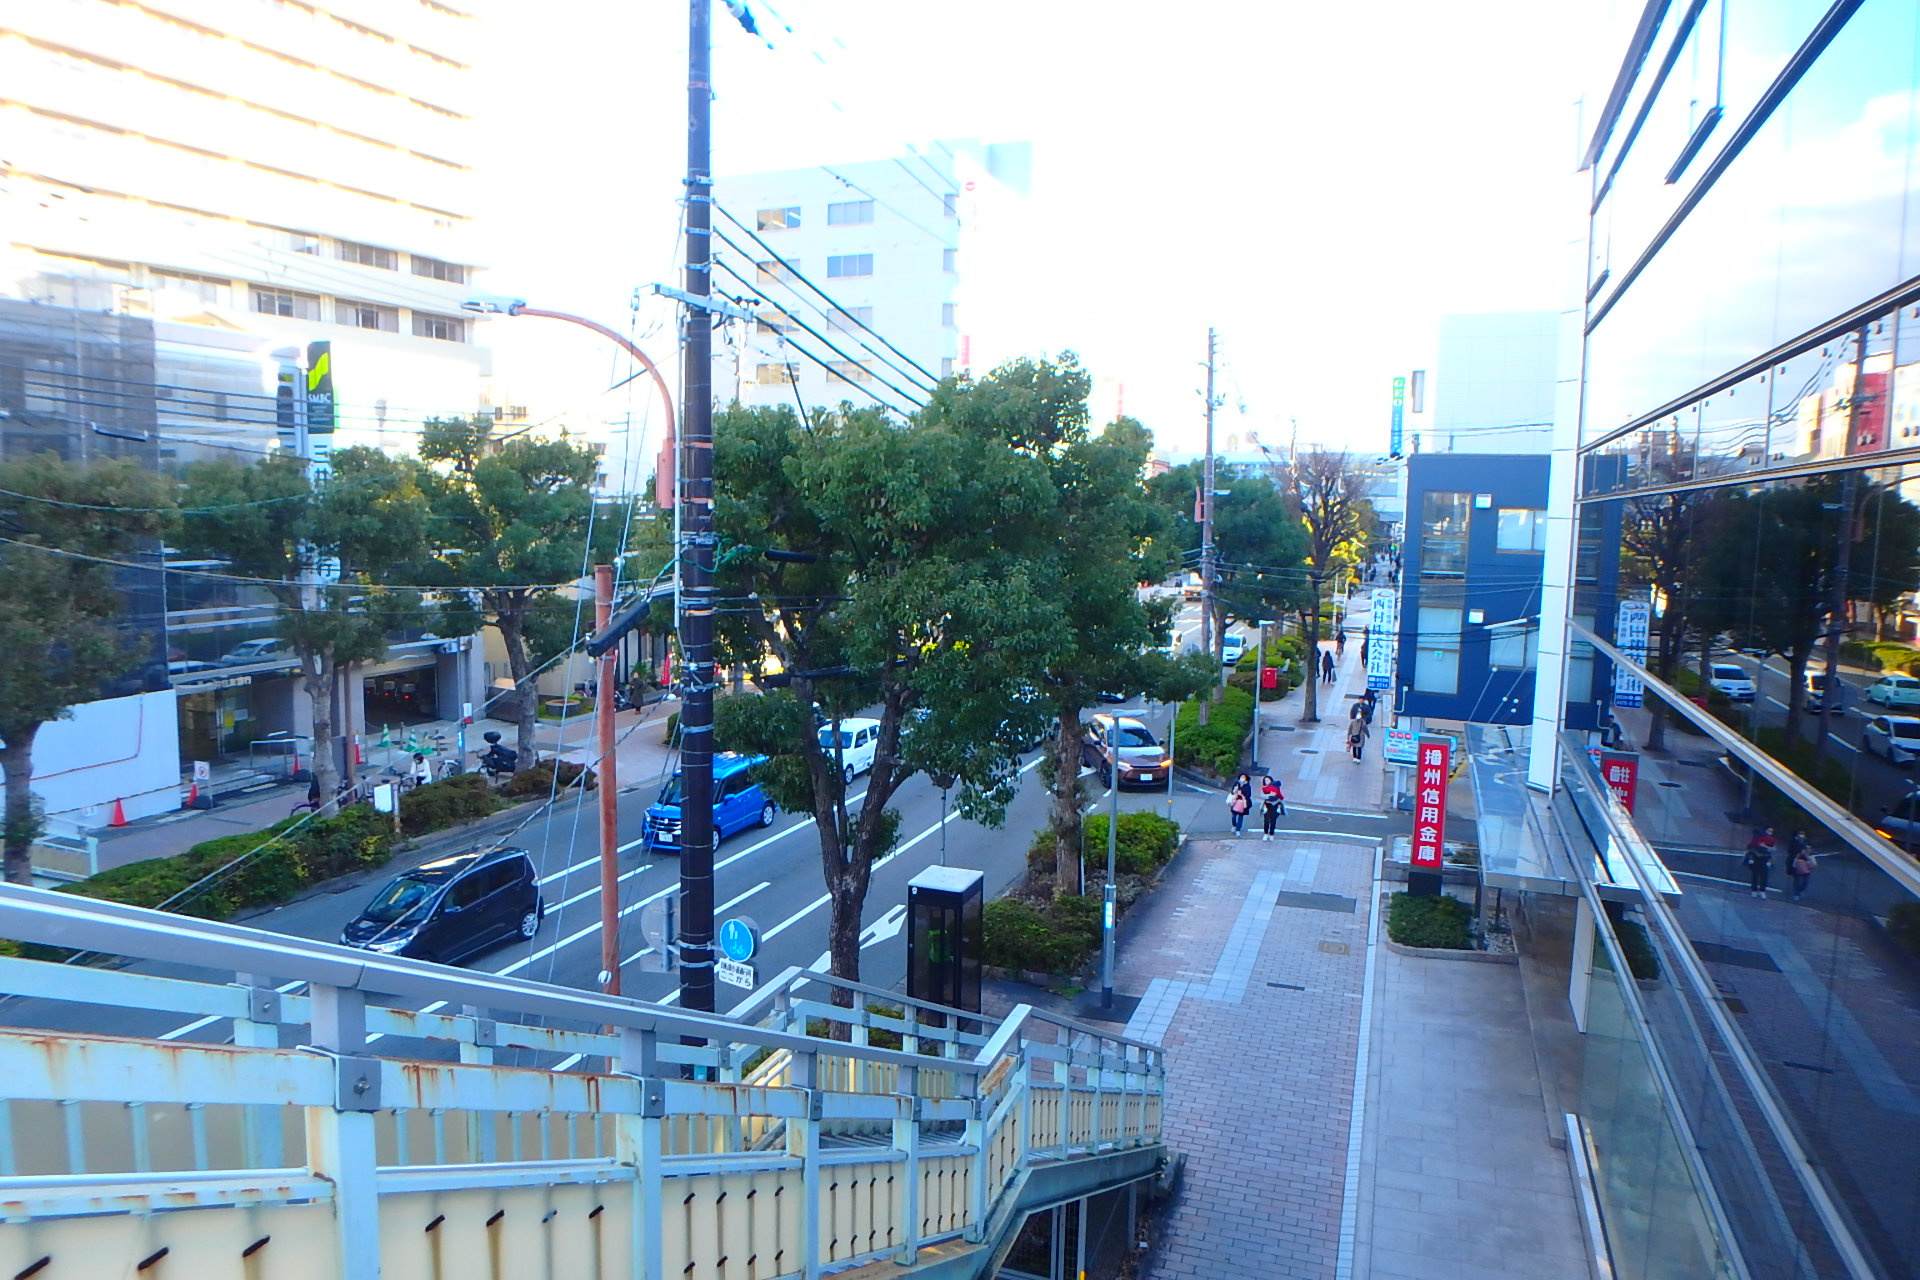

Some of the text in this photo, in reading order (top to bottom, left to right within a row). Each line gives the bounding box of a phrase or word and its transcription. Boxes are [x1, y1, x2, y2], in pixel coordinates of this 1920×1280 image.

[307, 392, 332, 403] SMBC
[1417, 749, 1443, 862] 播州信用金庫
[720, 970, 752, 987] ここから
